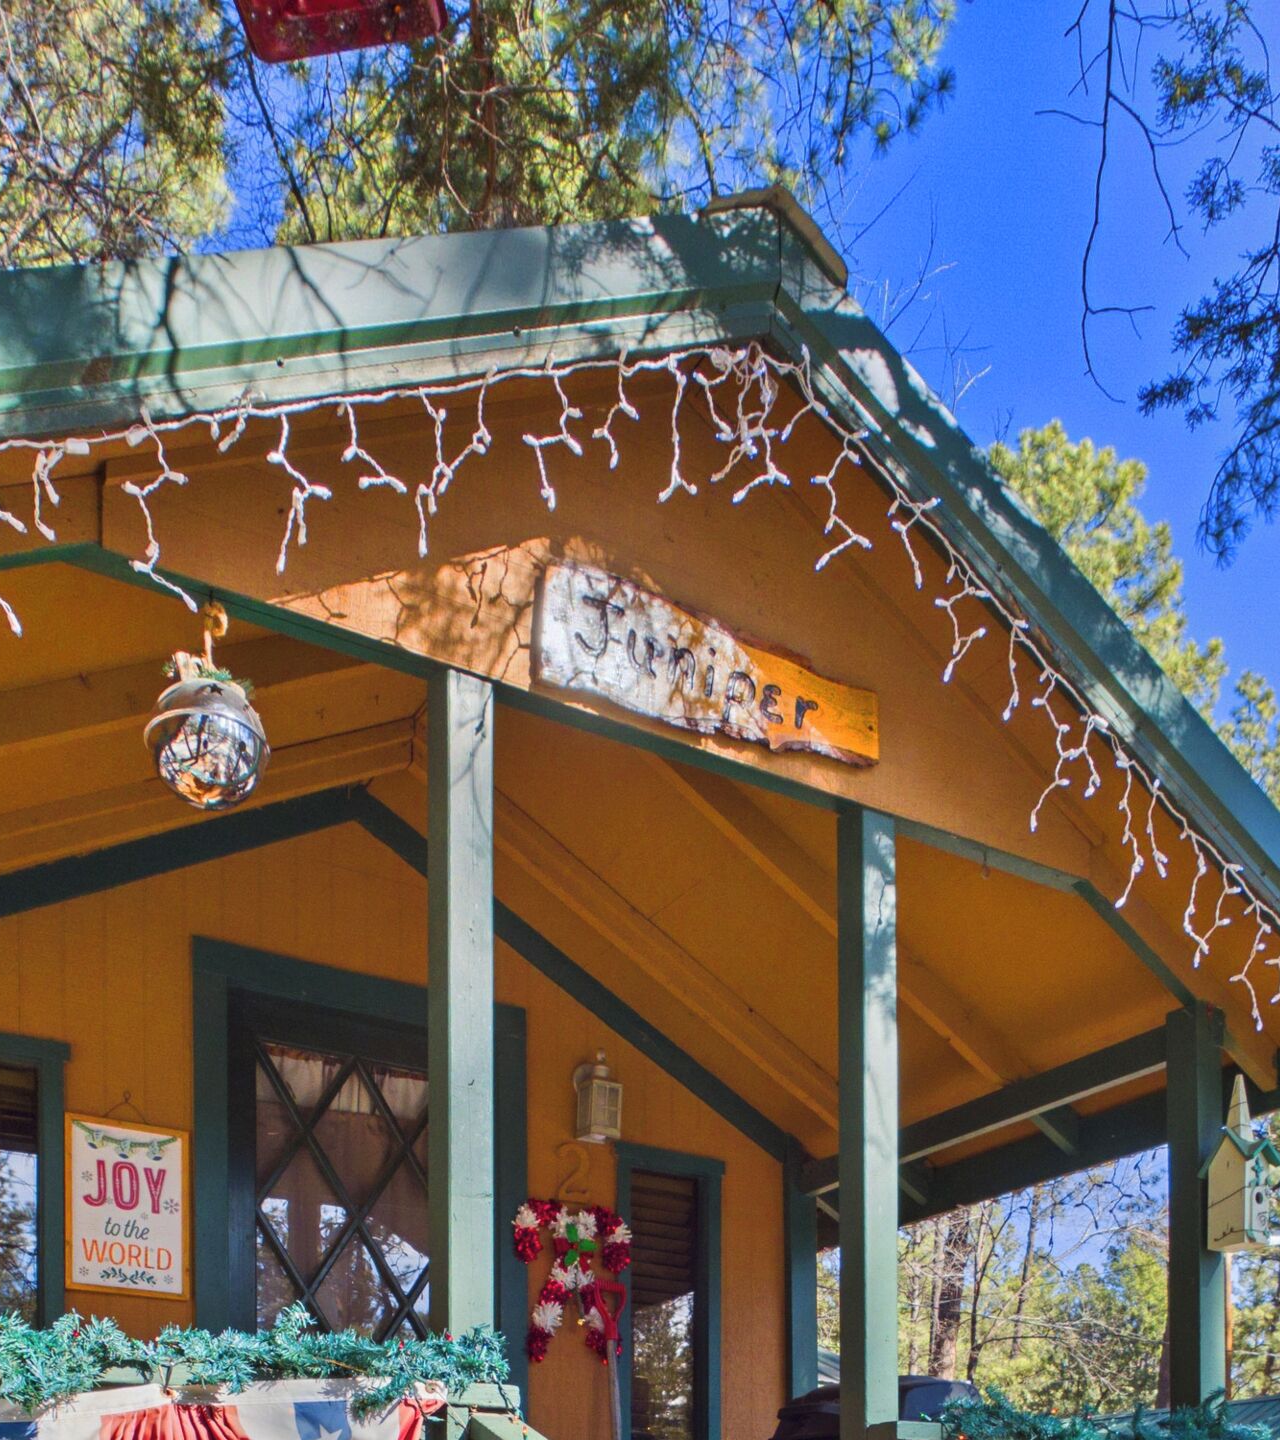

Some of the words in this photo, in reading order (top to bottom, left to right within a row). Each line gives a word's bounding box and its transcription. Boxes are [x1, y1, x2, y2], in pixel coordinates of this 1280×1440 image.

[83, 1160, 167, 1215] JOY
[104, 1217, 122, 1236] to
[124, 1219, 150, 1240] the
[81, 1237, 172, 1271] WORLD
